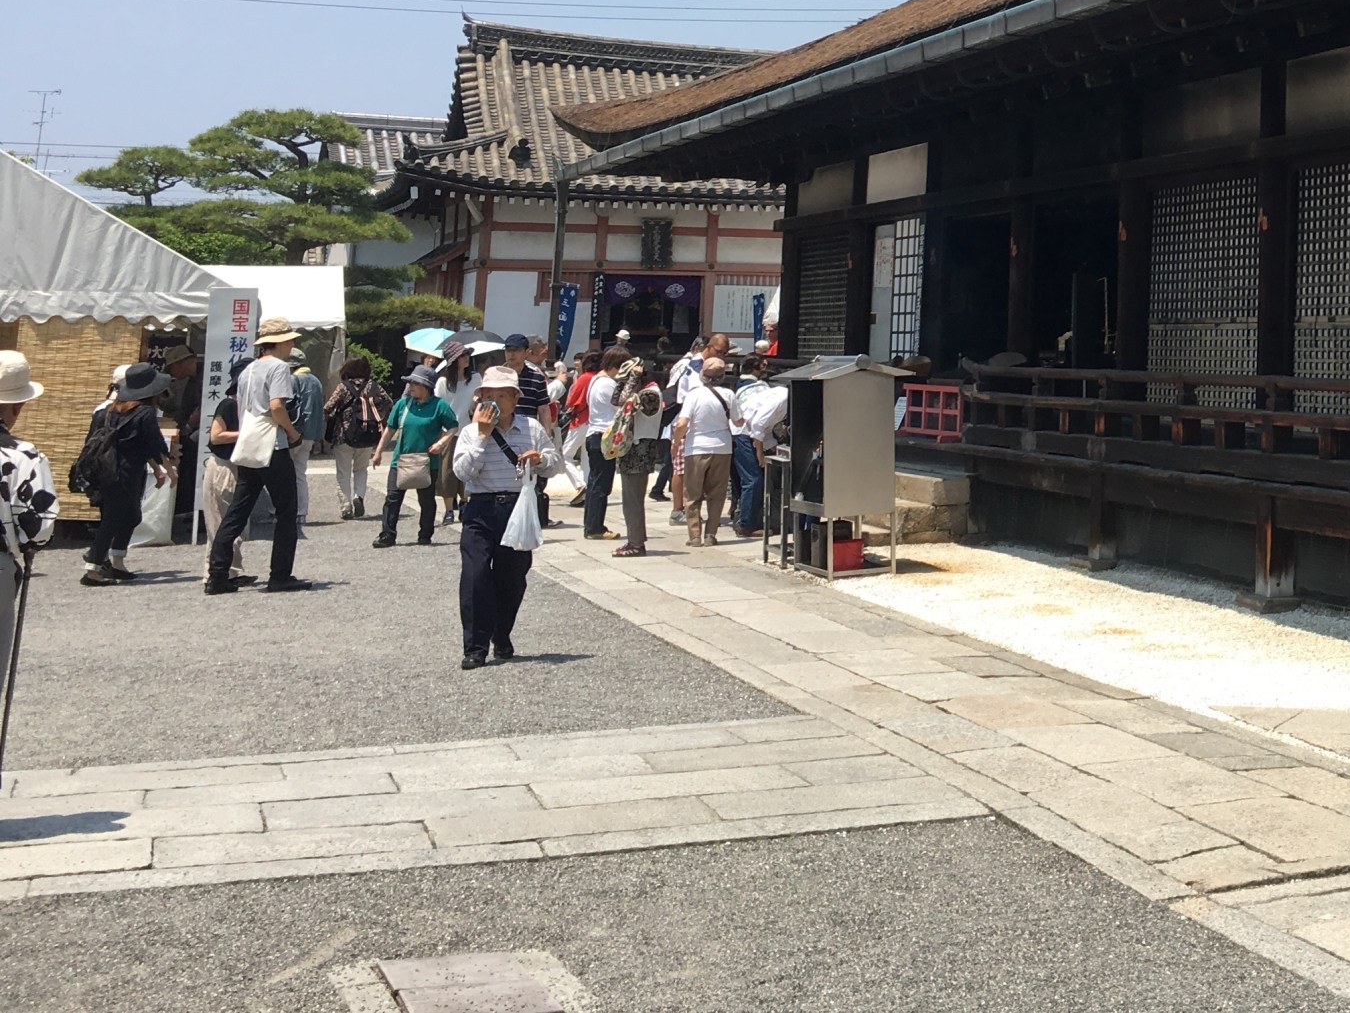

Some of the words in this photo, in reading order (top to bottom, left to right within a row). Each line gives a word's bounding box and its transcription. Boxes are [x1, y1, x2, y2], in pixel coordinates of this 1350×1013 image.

[231, 300, 250, 332] 国宝
[208, 361, 223, 401] 護摩木
